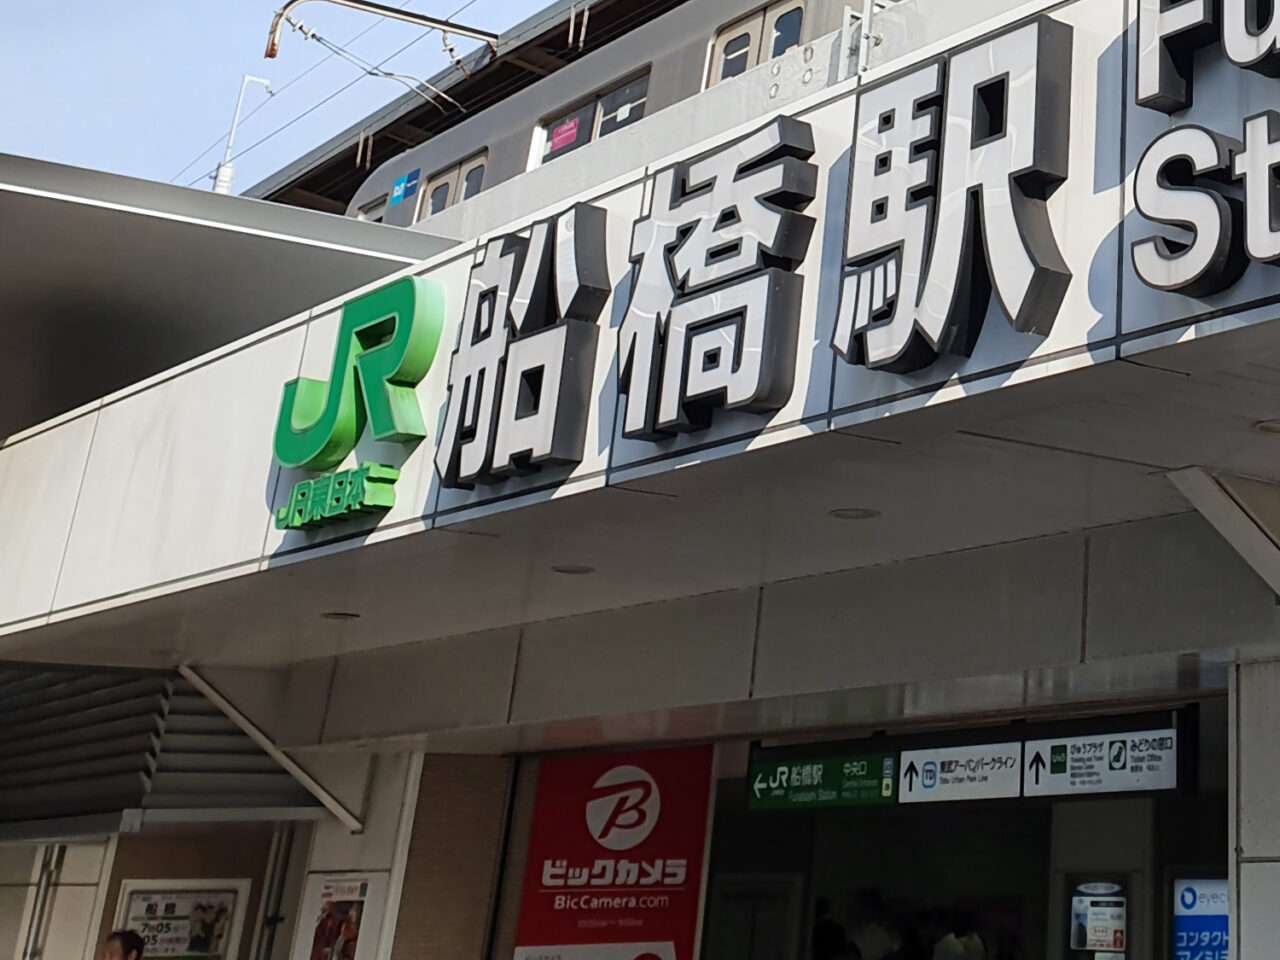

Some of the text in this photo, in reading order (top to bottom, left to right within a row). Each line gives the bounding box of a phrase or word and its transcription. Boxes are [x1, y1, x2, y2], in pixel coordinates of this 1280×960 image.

[435, 13, 1073, 489] 船橋駅
[273, 274, 447, 471] JR
[275, 461, 400, 530] JR東日本
[1130, 736, 1173, 752] みどりの窓口
[768, 764, 824, 788] JR 船橋駅
[541, 858, 688, 887] ビックカメラ
[552, 894, 670, 911] BicCamera.com
